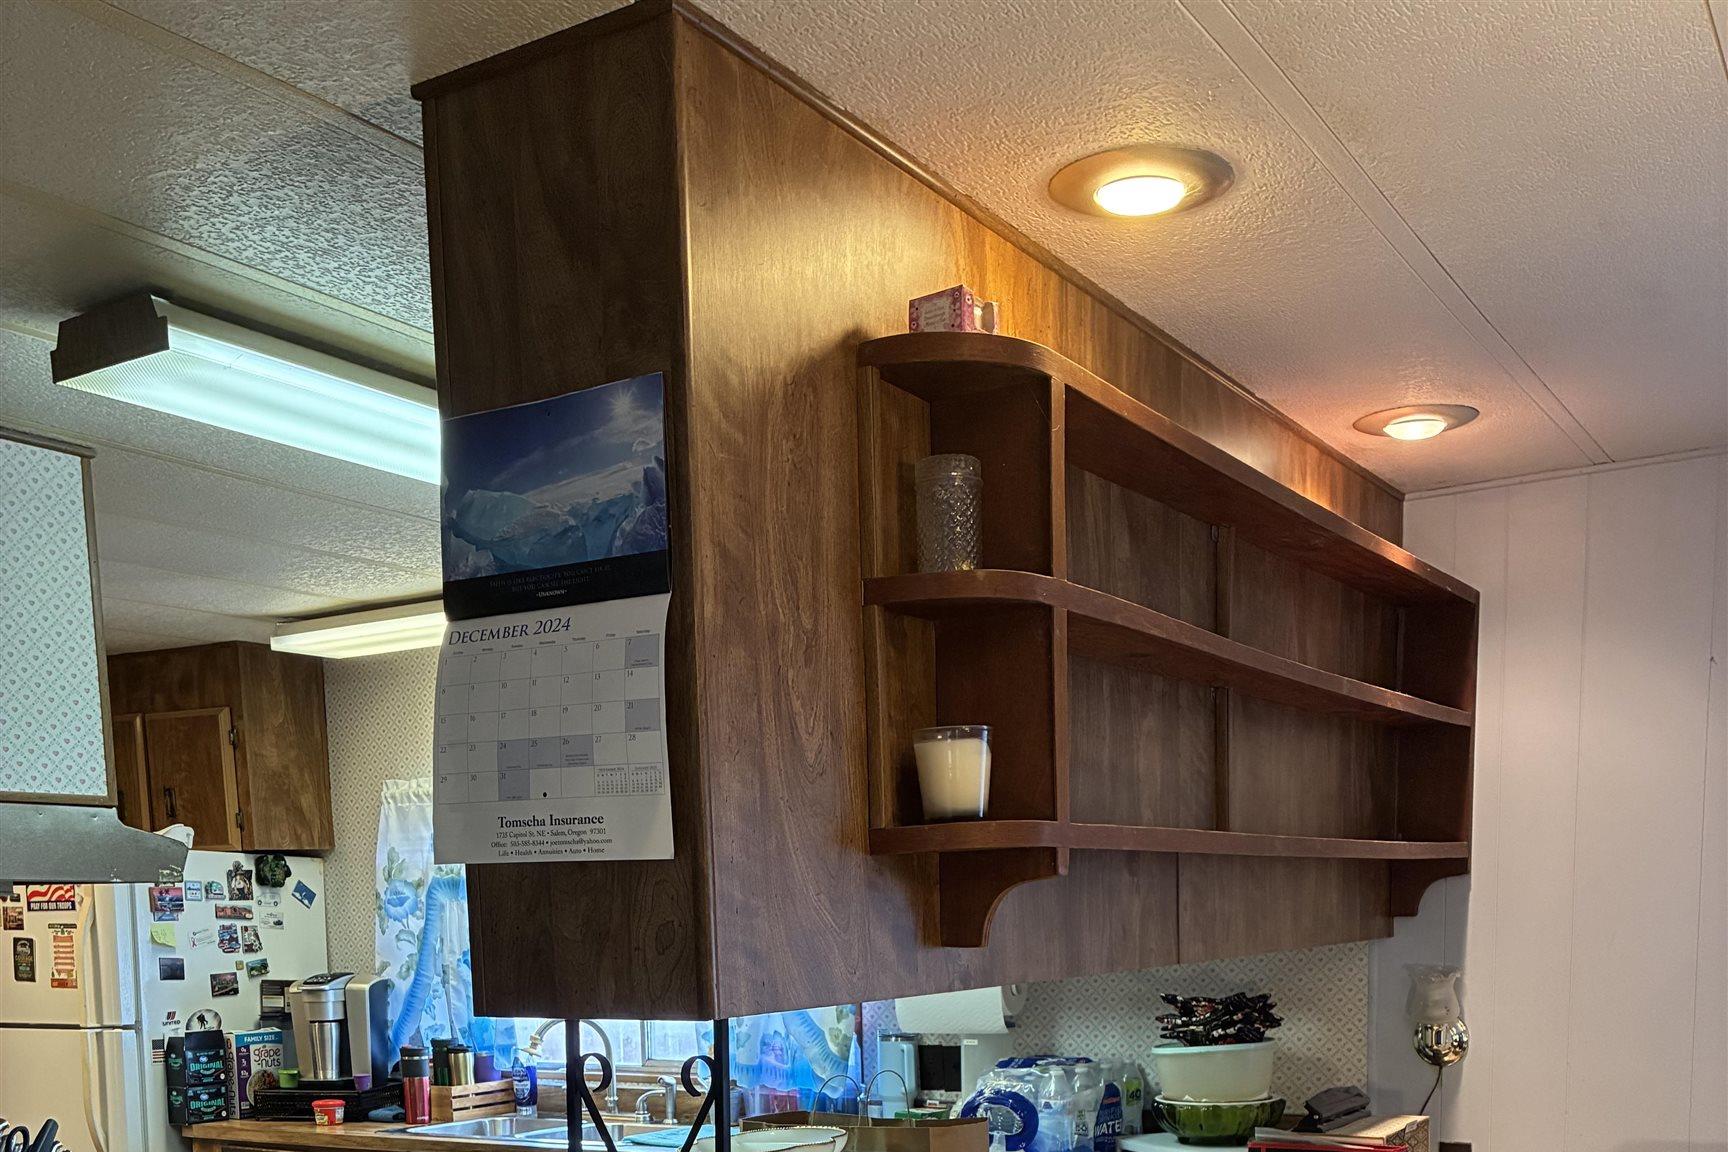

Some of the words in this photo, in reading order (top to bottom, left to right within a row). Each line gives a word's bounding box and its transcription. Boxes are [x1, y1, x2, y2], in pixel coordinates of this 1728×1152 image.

[448, 624, 529, 645] DECEMBER
[533, 617, 572, 635] 2024
[497, 815, 546, 828] Tomscha
[549, 814, 604, 826] Insurance
[567, 828, 587, 837] Oregon
[253, 1047, 281, 1063] grape
[190, 1061, 224, 1072] ORIGINAL
[190, 1098, 225, 1110] ORIGINAL
[1095, 1119, 1122, 1137] WATE
